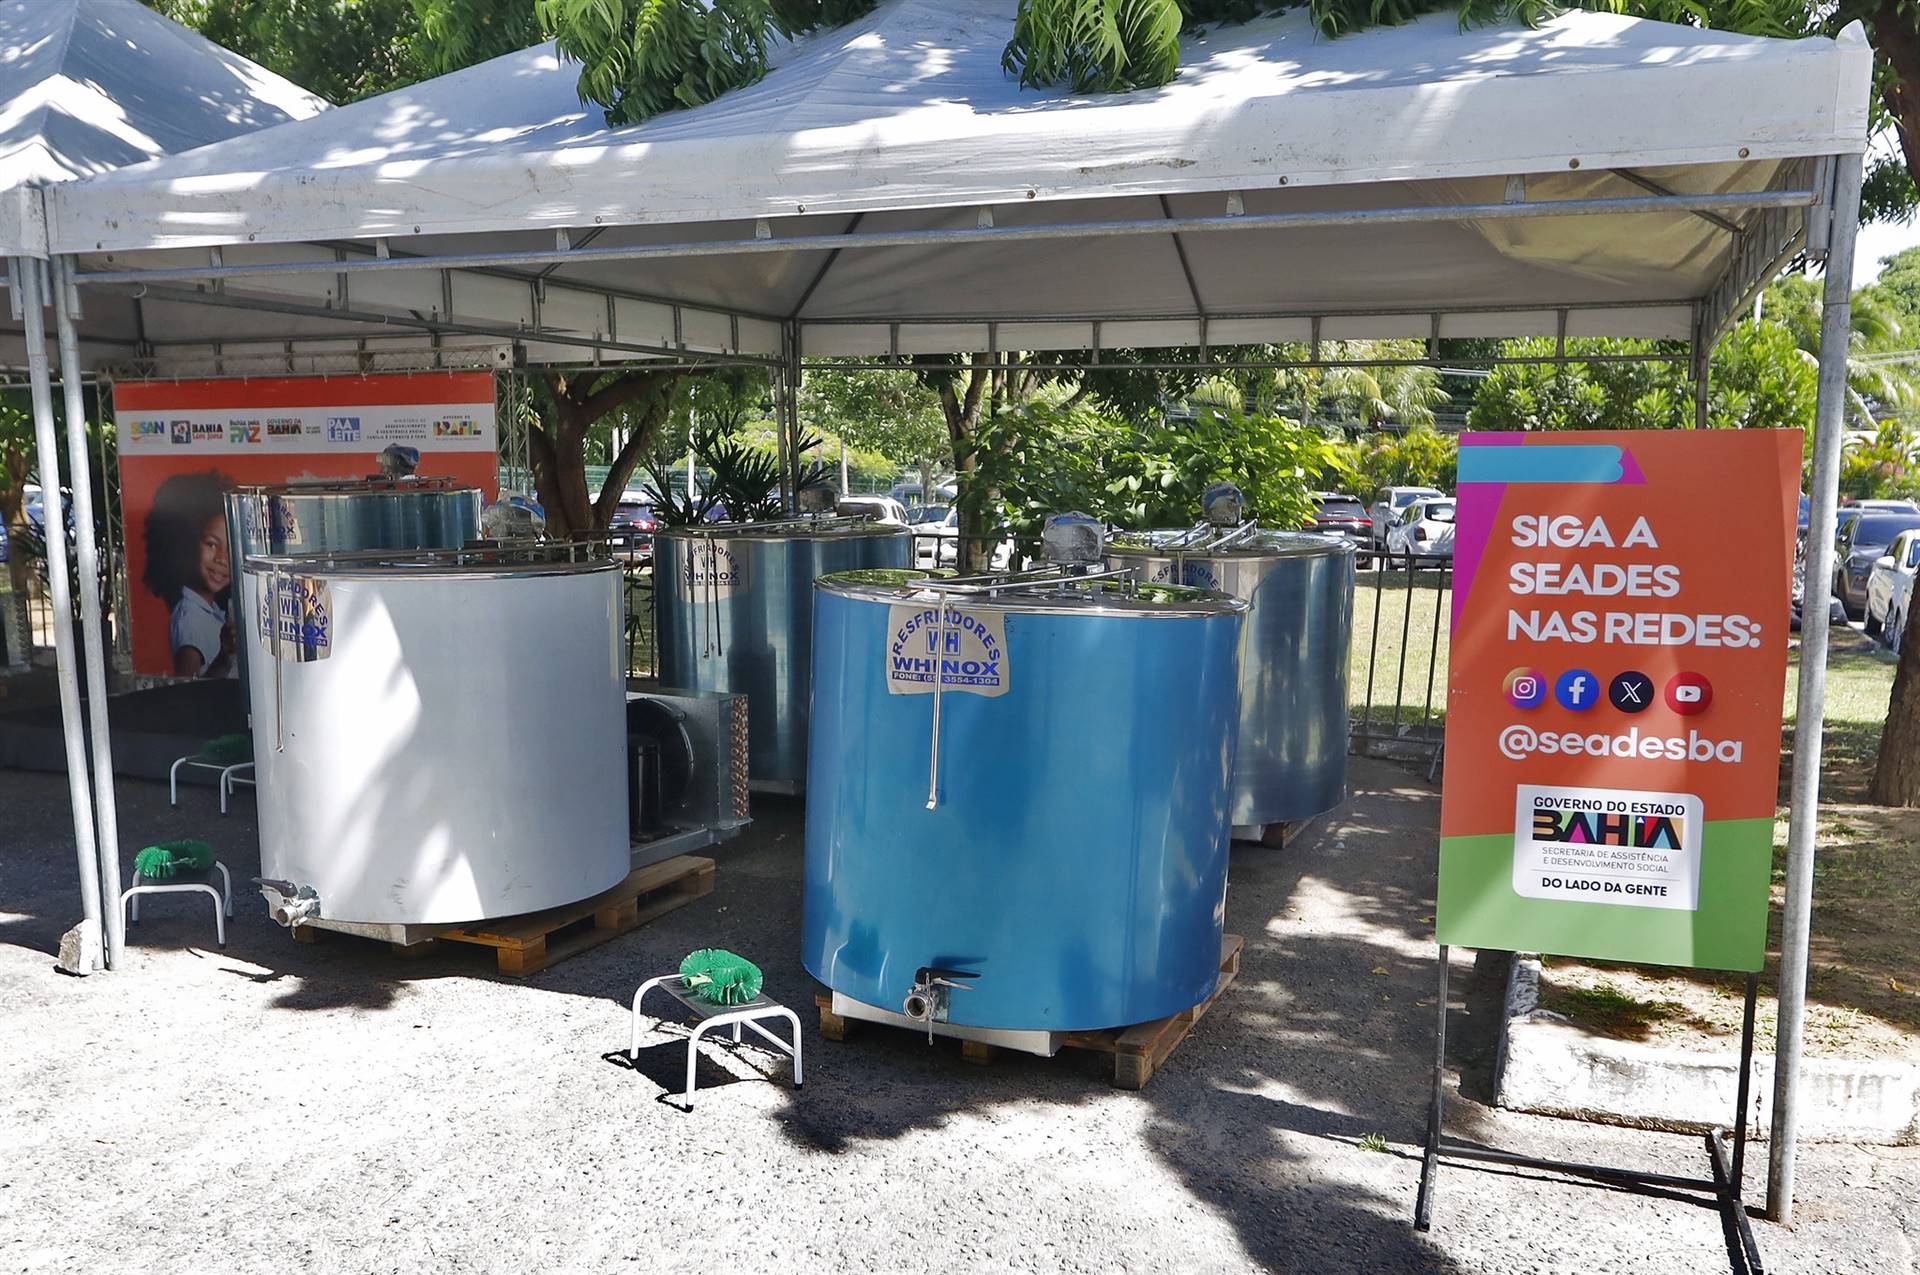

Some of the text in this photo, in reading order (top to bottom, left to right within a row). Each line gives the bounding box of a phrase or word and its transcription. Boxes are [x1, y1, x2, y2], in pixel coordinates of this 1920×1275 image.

[192, 424, 224, 433] BAHIA
[267, 424, 302, 435] BAHIA
[329, 418, 353, 430] PAA
[230, 426, 261, 443] PAZ
[329, 430, 360, 441] LEITE
[1511, 514, 1659, 549] SIGA A
[1508, 562, 1681, 598] SEADES
[1507, 608, 1762, 648] NAS REDES:
[893, 672, 921, 680] FONE:
[1498, 724, 1743, 763] @seadesba
[1534, 796, 1685, 816] GOVERNO DO ESTADO
[1532, 808, 1685, 850] BAHIA
[1542, 846, 1669, 862] SECRETARIA DE ASSISTÊNCIA
[1550, 857, 1635, 871] DESENVOLVIMENTO
[1637, 863, 1669, 873] SOCIAL
[1542, 877, 1667, 896] DO LADO DA GENTE
